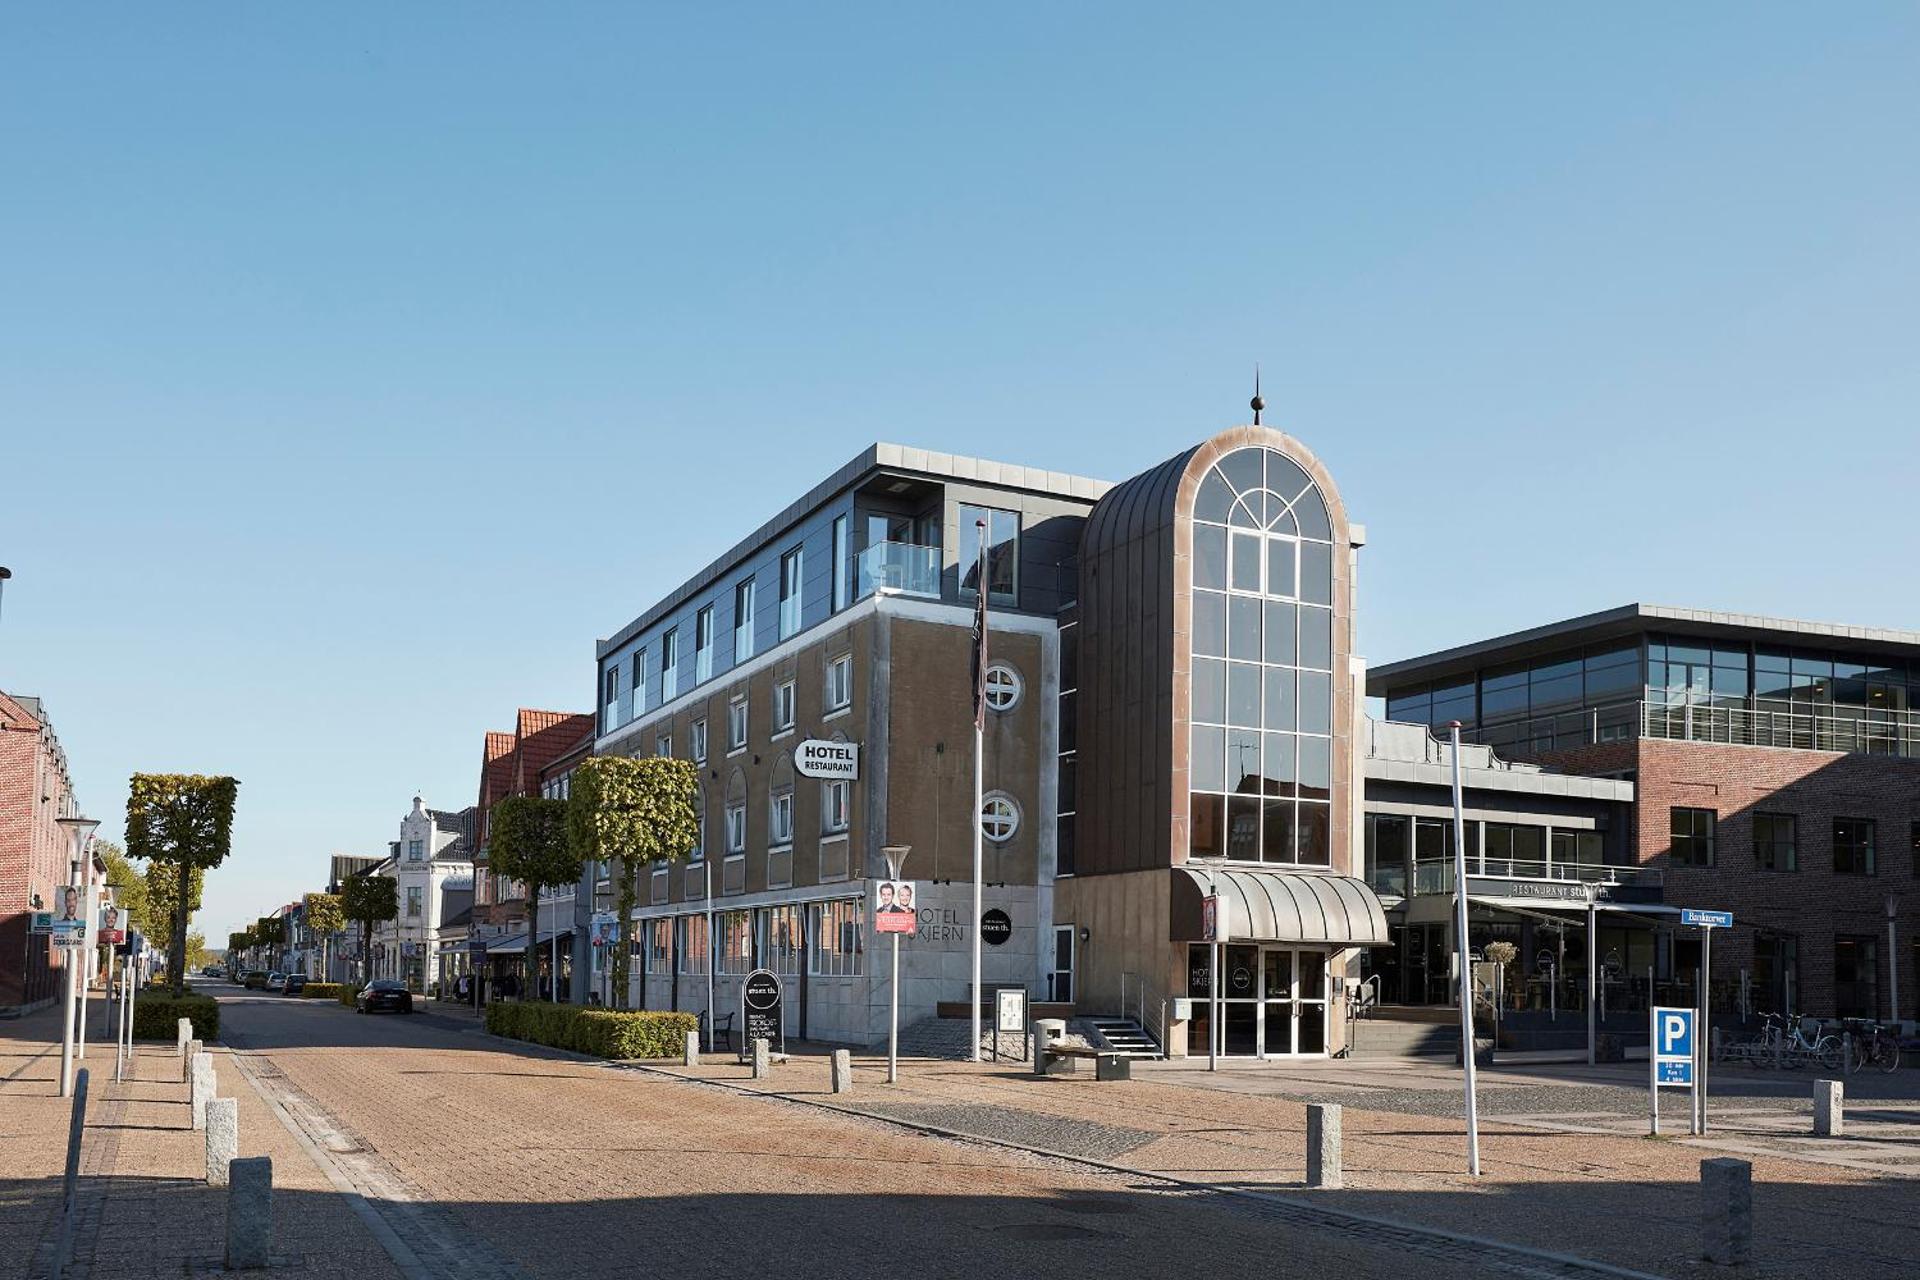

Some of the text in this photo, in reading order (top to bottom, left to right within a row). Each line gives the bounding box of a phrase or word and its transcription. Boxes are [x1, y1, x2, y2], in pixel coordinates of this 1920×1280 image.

[805, 745, 853, 760] HOTEL
[804, 761, 853, 773] RESTAURANT
[1513, 885, 1567, 897] RESTAURANT
[1570, 886, 1588, 897] stu
[1689, 912, 1726, 923] Banktorvet
[1664, 1015, 1686, 1052] P
